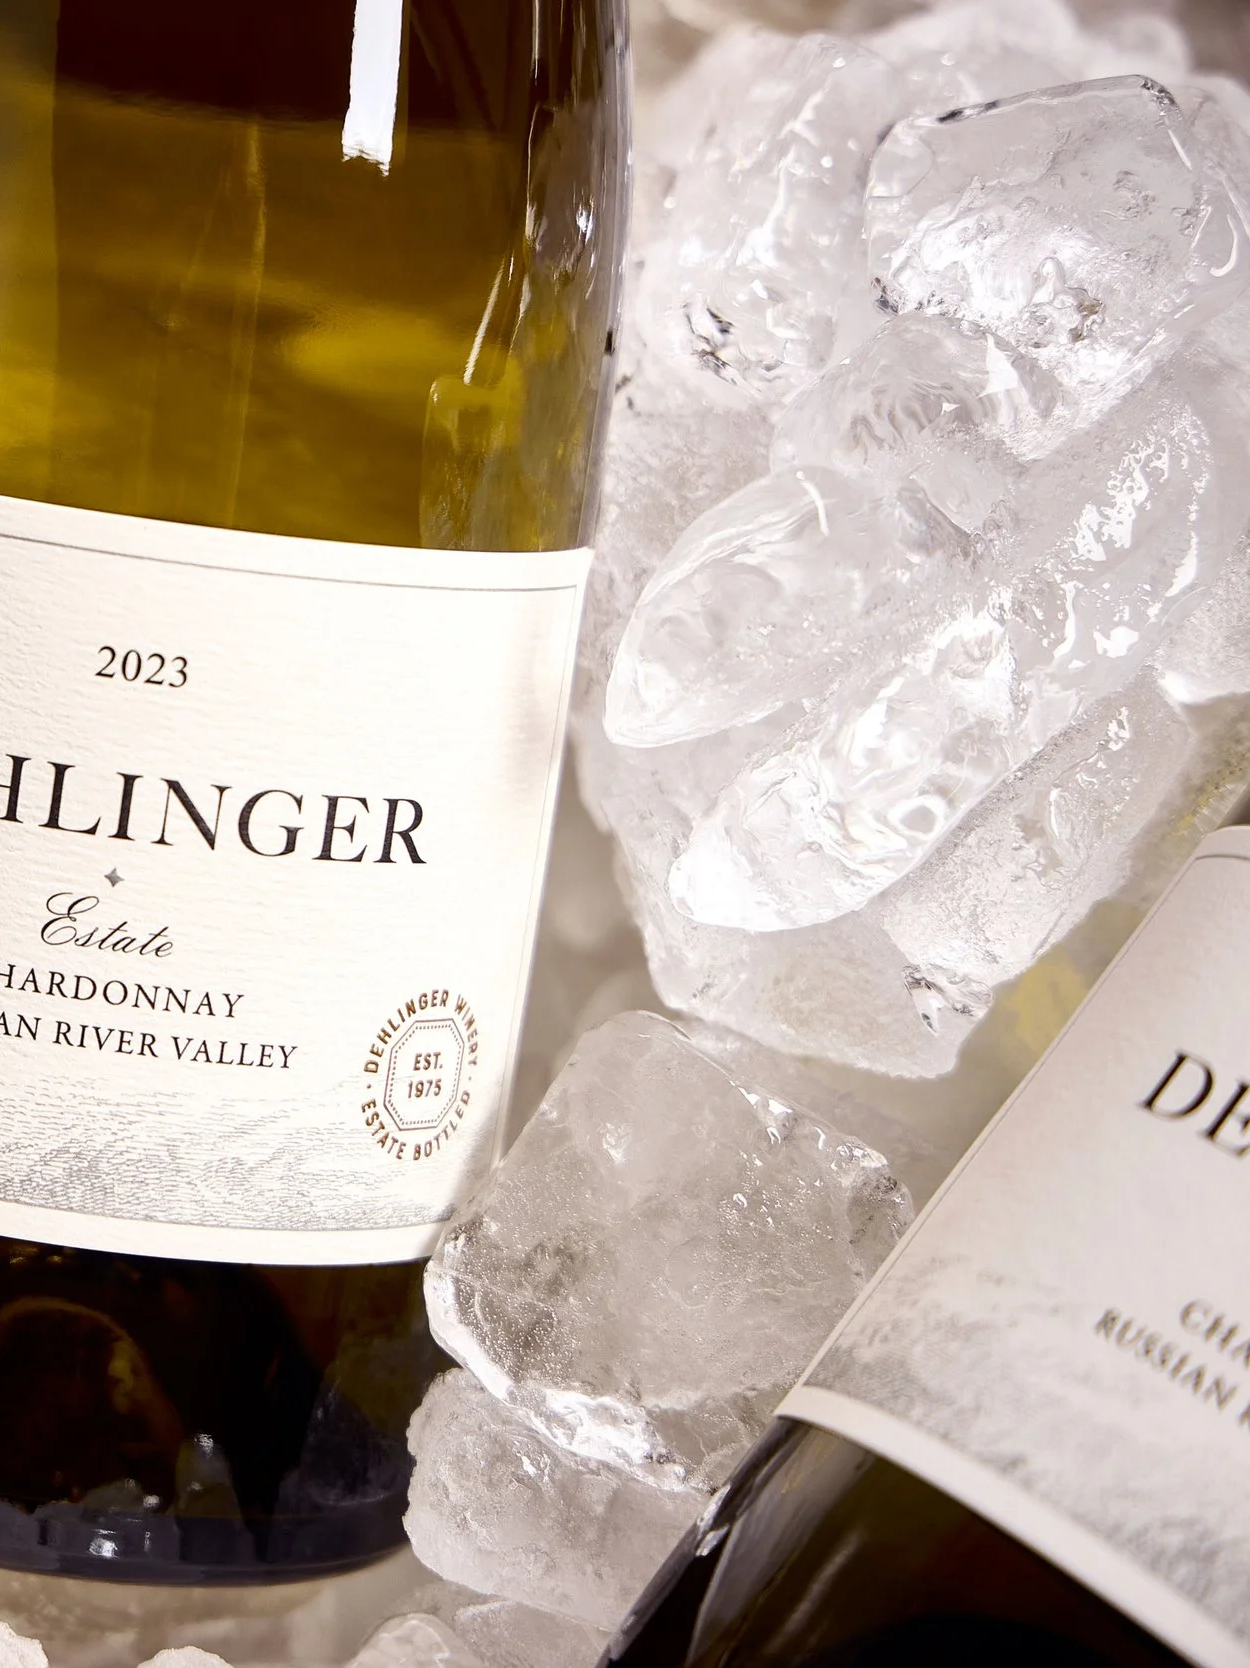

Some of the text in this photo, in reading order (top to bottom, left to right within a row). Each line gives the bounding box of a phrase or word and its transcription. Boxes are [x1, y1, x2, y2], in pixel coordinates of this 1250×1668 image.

[94, 645, 190, 688] 2023
[40, 891, 175, 958] Estate
[52, 1020, 159, 1058] RIVER
[170, 1036, 298, 1069] VALLEY
[363, 988, 479, 1075] DEHLINGER WINERY
[407, 1079, 443, 1099] 1975
[413, 1051, 443, 1071] EST.
[361, 1089, 471, 1162] ESTATE BOTTLED
[1093, 1308, 1240, 1414] RUSSIAN
